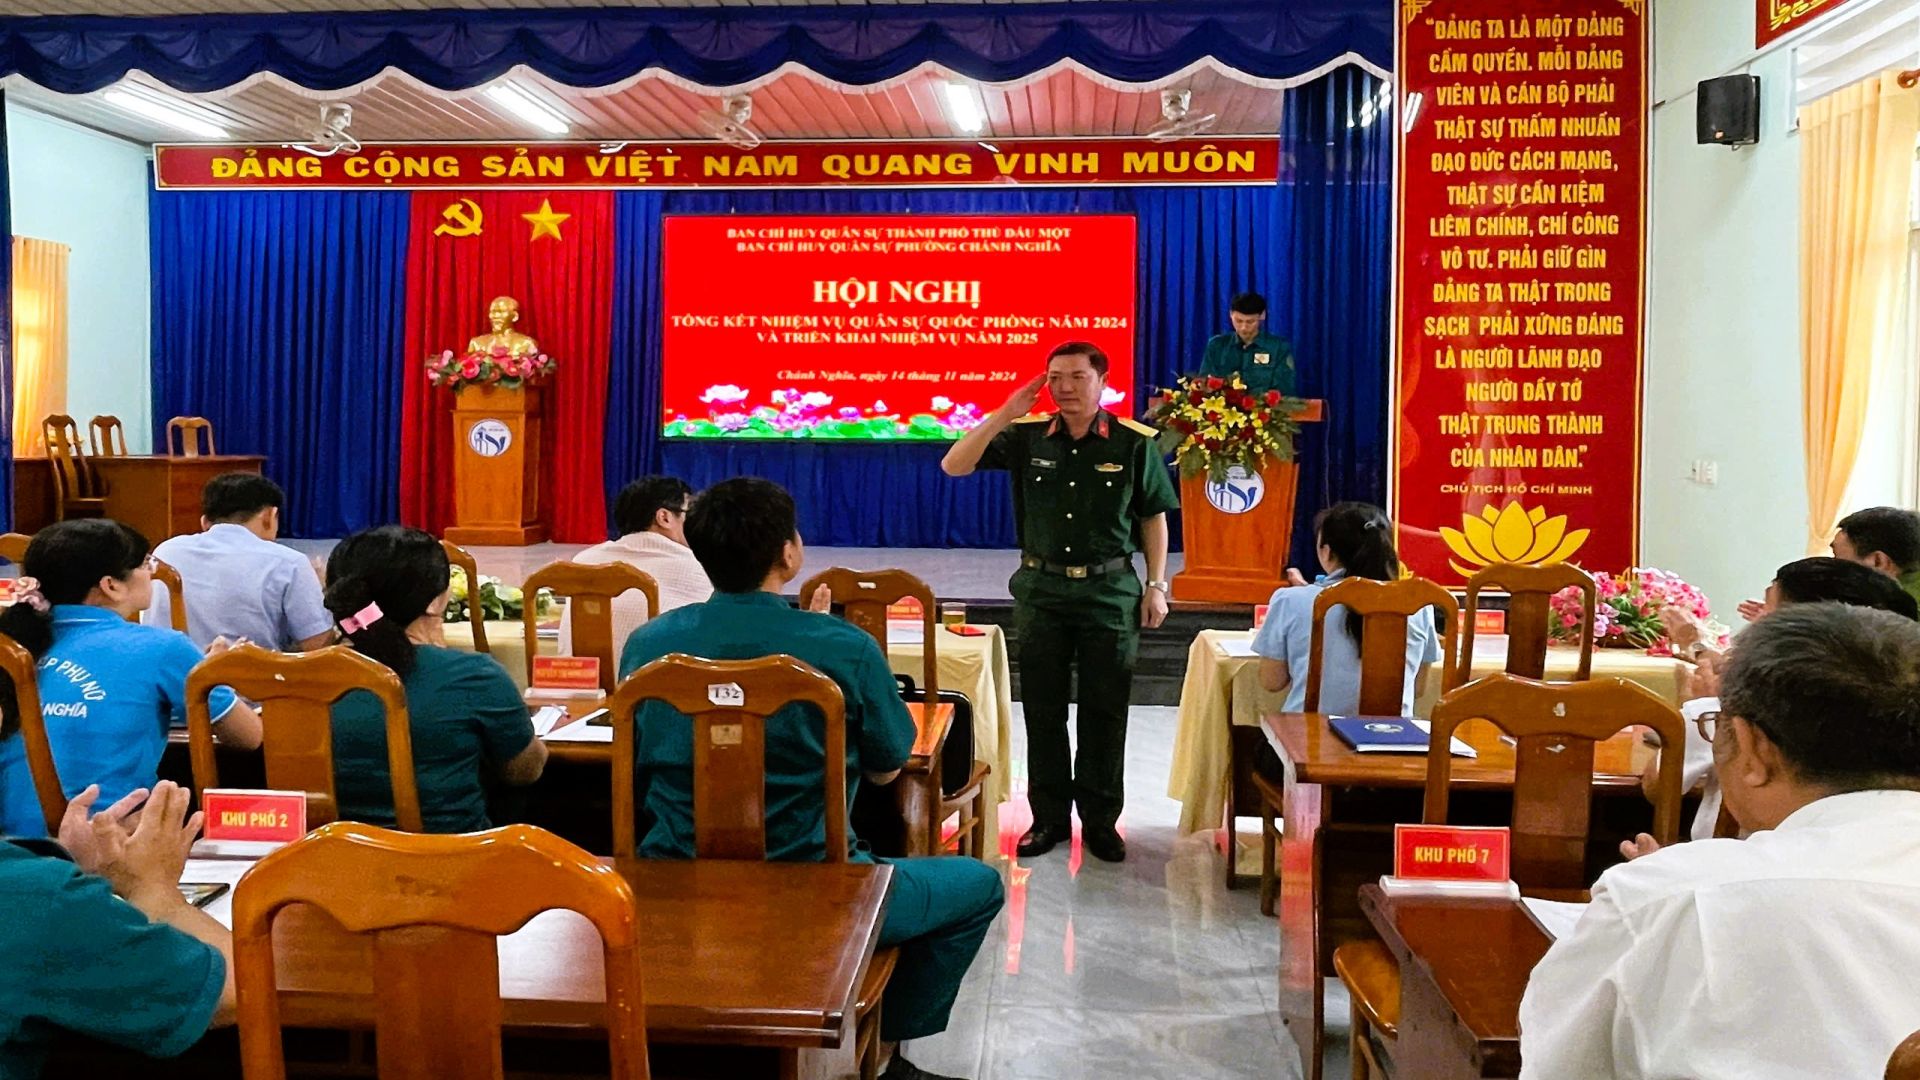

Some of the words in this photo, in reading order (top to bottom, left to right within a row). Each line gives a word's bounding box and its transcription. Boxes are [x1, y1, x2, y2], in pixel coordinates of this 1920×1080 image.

[1487, 20, 1504, 38] TA
[1511, 14, 1530, 38] LÀ
[1536, 14, 1572, 41] MỘT
[1577, 11, 1624, 36] ĐẢNG
[1538, 44, 1571, 71] MỖI
[1576, 43, 1623, 69] ĐẢNG
[1436, 83, 1475, 106] VIÊN
[1480, 81, 1501, 105] VÀ
[1506, 81, 1541, 104] CÁN
[1547, 80, 1569, 107] BỘ
[1575, 77, 1614, 103] PHẢI
[1434, 116, 1475, 143] THẬT
[1481, 117, 1504, 142] SỰ
[211, 148, 322, 178] ĐẢNG
[344, 151, 459, 183] CỘNG
[482, 148, 565, 178] SẢN
[586, 150, 682, 182] VIỆT
[704, 154, 798, 176] NAM
[822, 154, 973, 177] QUANG
[998, 152, 1099, 173] VINH
[1123, 145, 1256, 173] MUÔN
[1431, 153, 1465, 175] ĐẠO
[1470, 147, 1504, 171] ĐỨC
[1510, 146, 1555, 170] CÁCH
[1560, 151, 1618, 173] MẠNG,
[1447, 182, 1487, 208] THẬT
[1493, 184, 1518, 208] SỰ
[1561, 181, 1604, 207] KIỆM
[727, 229, 756, 238] BAN
[788, 229, 816, 238] HUY
[820, 227, 860, 240] QUÂN
[864, 228, 883, 240] SỰ
[885, 227, 935, 238] THÀNH
[1430, 214, 1471, 236] LIÊM
[1476, 212, 1533, 237] CHÍNH,
[1538, 212, 1566, 235] CHÍ
[1572, 212, 1619, 235] CÔNG
[737, 243, 765, 252] BAN
[797, 243, 826, 252] HUY
[830, 241, 870, 253] QUÂN
[873, 242, 893, 254] SỰ
[959, 240, 1011, 252] CHÁNH
[1015, 240, 1061, 252] NGHĨA
[1441, 246, 1462, 269] VÔ
[1468, 249, 1493, 269] TƯ.
[1498, 244, 1537, 268] PHẢI
[1543, 245, 1572, 268] GIỮ
[1576, 246, 1606, 268] GÌN
[813, 277, 878, 309] HỘI
[886, 281, 981, 309] NGHỊ
[1433, 277, 1479, 302] ĐẢNG
[1484, 283, 1503, 302] TA
[1509, 279, 1549, 305] THẬT
[1555, 282, 1611, 302] TRONG
[762, 316, 818, 329] NHIỆM
[822, 316, 846, 330] VỤ
[850, 313, 898, 329] QUÂN
[902, 315, 926, 330] SỰ
[983, 315, 1044, 328] PHÒNG
[1093, 317, 1127, 328] 2024
[1425, 316, 1469, 340] SẠCH
[1480, 310, 1519, 335] PHẢI
[1524, 312, 1572, 335] XỨNG
[1576, 312, 1623, 335] ĐÁNG
[757, 330, 779, 343] VÀ
[835, 333, 876, 343] KHAI
[880, 333, 934, 345] NHIỆM
[939, 333, 961, 346] VỤ
[965, 331, 1003, 344] NĂM
[1006, 333, 1038, 344] 2025
[1436, 345, 1456, 369] LÀ
[1461, 344, 1513, 369] NGƯỜI
[1518, 345, 1562, 368] LÃNH
[1568, 349, 1601, 372] ĐẠO
[777, 370, 815, 380] Chánh
[860, 371, 887, 381] ngày
[891, 371, 904, 380] 14
[907, 371, 940, 382] tháng
[989, 372, 1017, 381] 2024
[1466, 378, 1517, 402] NGƯỜI
[1561, 378, 1582, 401] TỚ
[1439, 412, 1480, 437] THẬT
[1485, 415, 1540, 434] TRUNG
[1547, 412, 1603, 434] THÀNH
[1451, 442, 1484, 467] CỦA
[1490, 445, 1536, 467] NHÂN
[1441, 482, 1468, 493] CHỦ
[1473, 485, 1503, 494] TỊCH
[1531, 483, 1554, 494] CHÍ
[1558, 486, 1592, 494] MINH
[221, 812, 246, 826] KHU
[250, 808, 276, 827] PHỐ
[279, 814, 288, 828] 2
[1414, 846, 1443, 862] KHU
[1447, 842, 1476, 864] PHỐ
[1481, 848, 1489, 864] 7
